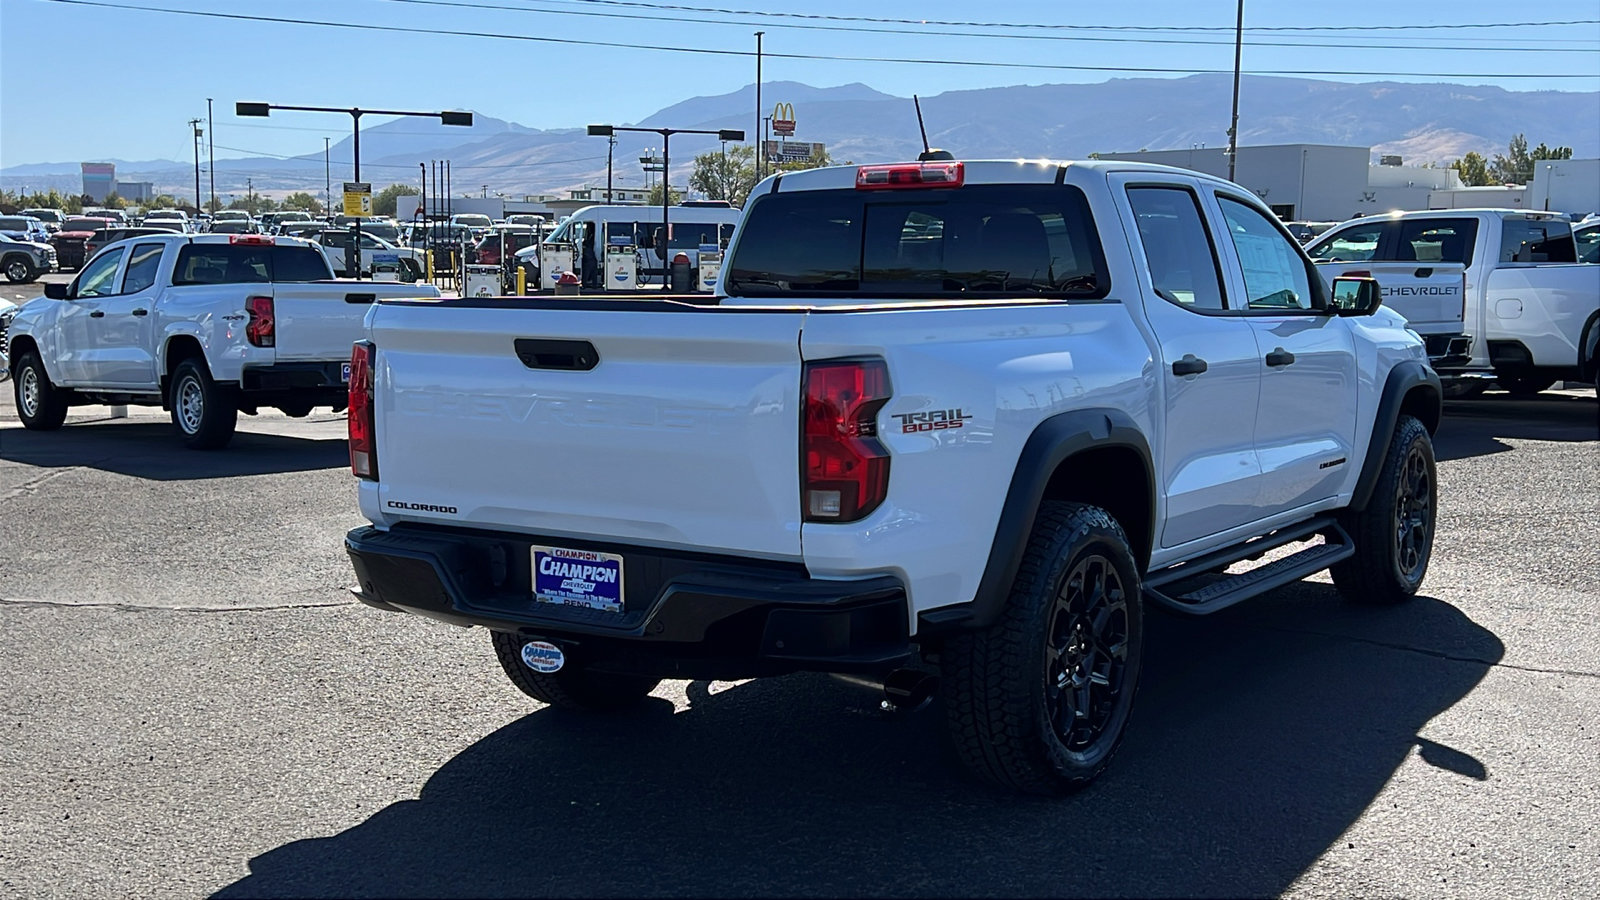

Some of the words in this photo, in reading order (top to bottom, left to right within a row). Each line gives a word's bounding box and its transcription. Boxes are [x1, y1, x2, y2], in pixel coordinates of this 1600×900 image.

[1381, 286, 1459, 296] CHEVROLET
[891, 408, 973, 424] TRAIL
[902, 419, 963, 434] BOSS
[387, 500, 458, 514] COLORADO
[555, 549, 598, 561] CHAMPION
[540, 556, 617, 583] CHAMPION
[562, 580, 594, 590] CHEVROLET
